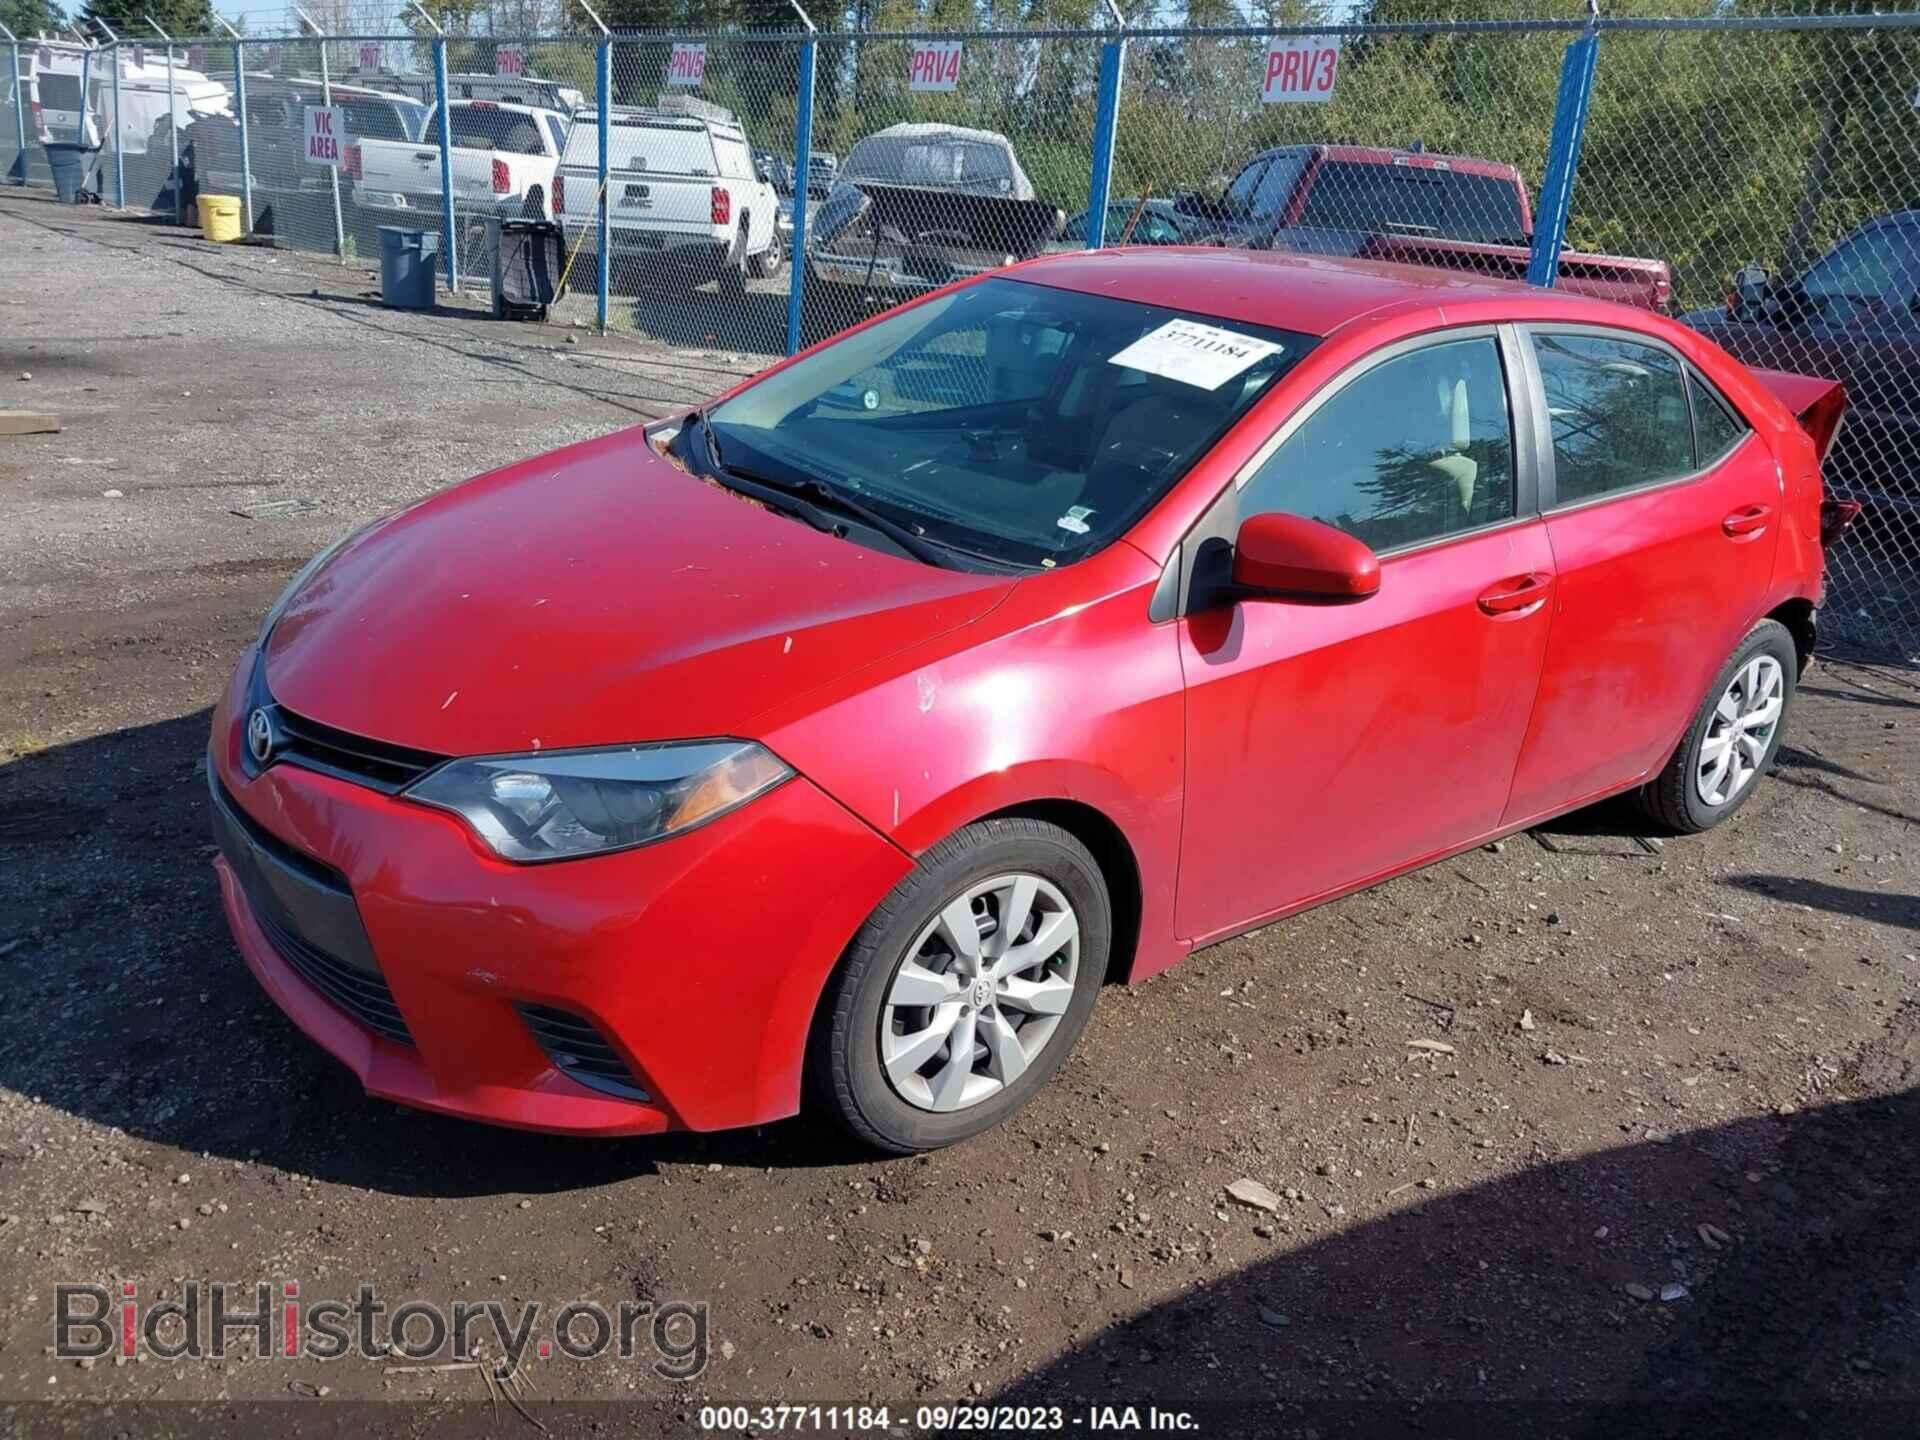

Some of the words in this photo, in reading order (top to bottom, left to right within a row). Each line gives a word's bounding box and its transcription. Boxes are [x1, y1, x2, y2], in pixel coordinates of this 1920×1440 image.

[671, 51, 704, 78] PRV5
[912, 50, 960, 82] PRV4
[1264, 48, 1337, 92] PRV3
[314, 111, 332, 135] VIC
[310, 136, 339, 160] AREA
[1164, 330, 1250, 359] 37711184
